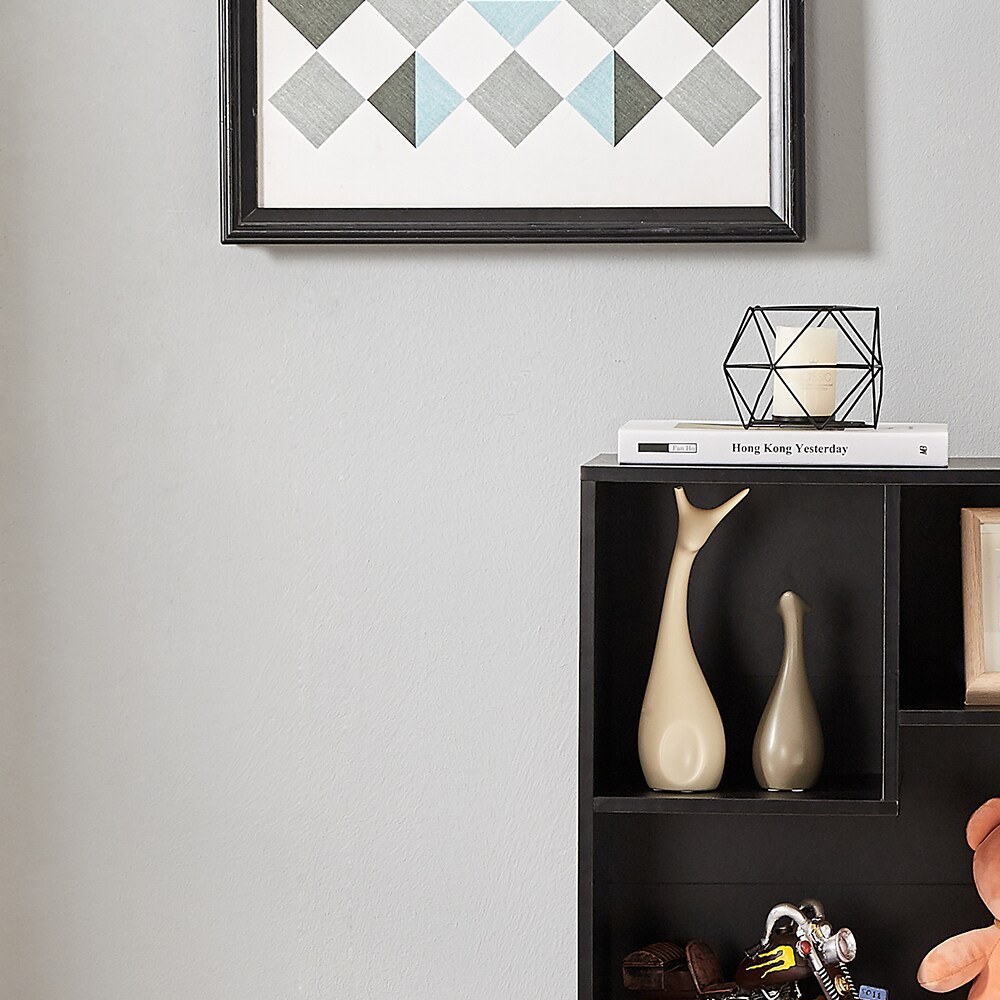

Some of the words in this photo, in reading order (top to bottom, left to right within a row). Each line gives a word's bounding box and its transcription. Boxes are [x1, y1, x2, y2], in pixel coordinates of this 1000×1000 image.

[732, 443, 761, 455] Hong
[764, 443, 792, 455] Kong
[795, 443, 849, 456] Yesterday
